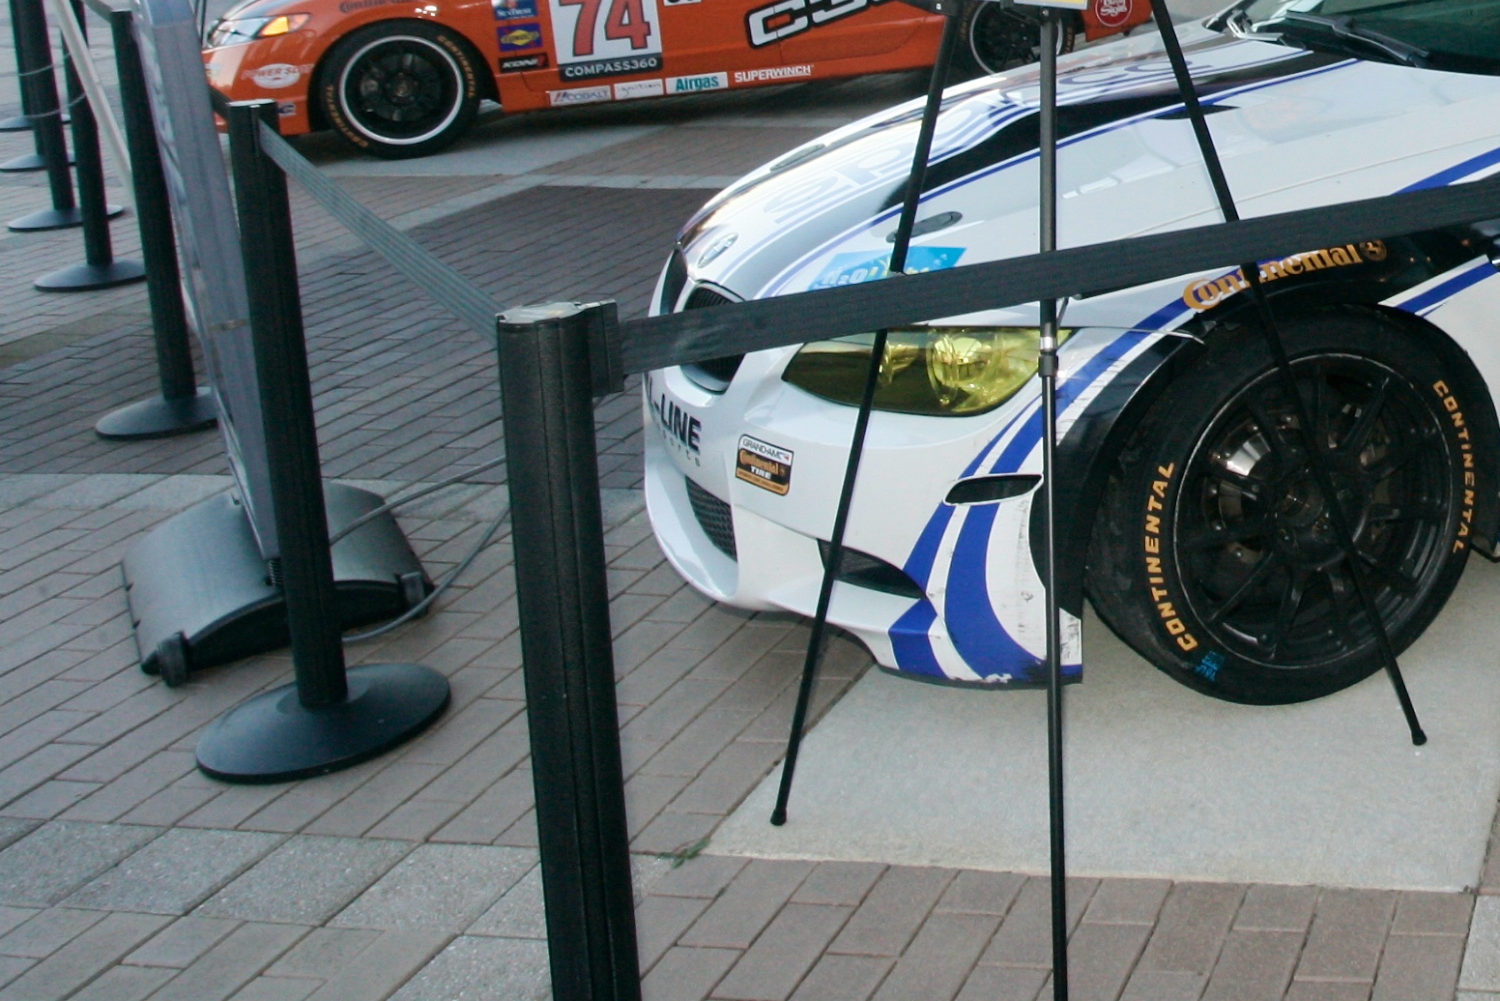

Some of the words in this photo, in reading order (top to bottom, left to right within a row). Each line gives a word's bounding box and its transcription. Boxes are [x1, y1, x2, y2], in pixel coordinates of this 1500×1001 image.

[565, 58, 658, 78] COMPASS360
[675, 74, 720, 92] Airgas
[734, 64, 812, 82] SUPERWINCH
[1183, 243, 1364, 310] Contnental
[1432, 380, 1476, 554] CONTINENTAL
[1143, 462, 1198, 652] CONTINENTAL
